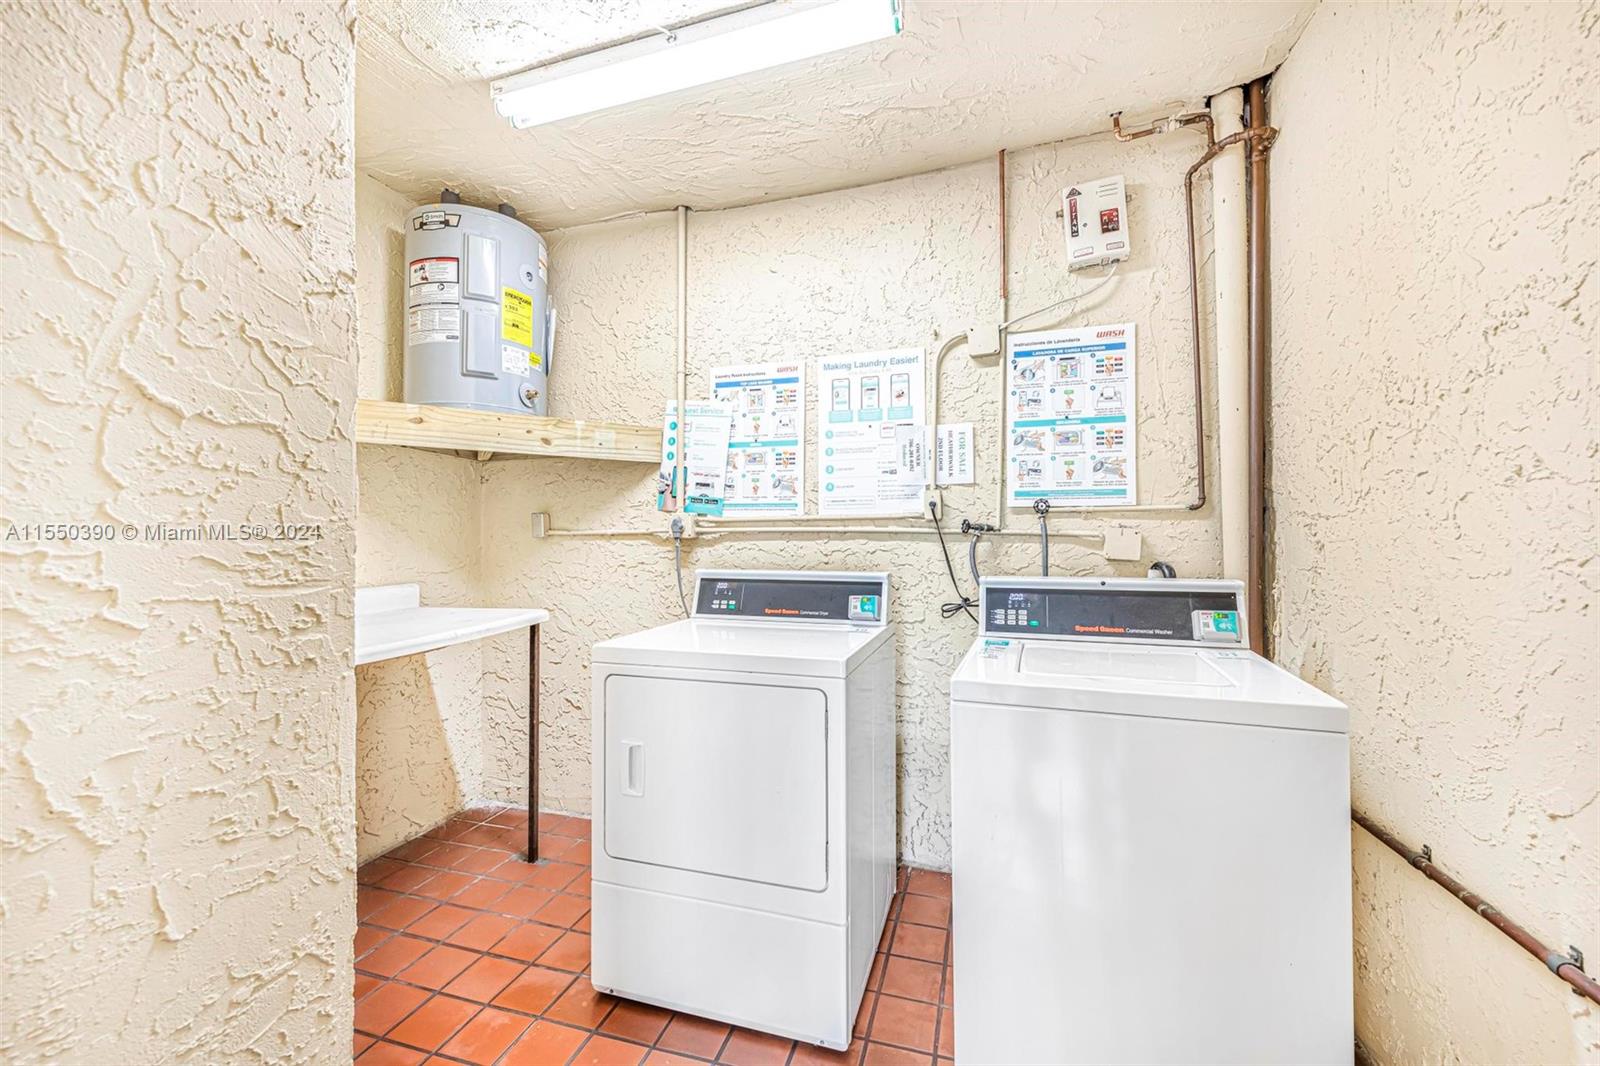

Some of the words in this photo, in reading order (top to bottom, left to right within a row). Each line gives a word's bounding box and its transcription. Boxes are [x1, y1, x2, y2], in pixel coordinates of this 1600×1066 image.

[1070, 199, 1079, 233] TITAN
[1096, 329, 1126, 338] WASH
[823, 362, 853, 372] Making
[854, 359, 888, 369] Laundry
[889, 355, 919, 366] Easier!
[958, 431, 966, 450] FOR
[958, 452, 966, 475] SALE
[764, 608, 782, 616] Speed
[1075, 624, 1099, 634] Speed
[1099, 626, 1125, 635] Queen
[1125, 627, 1154, 635] Commercial
